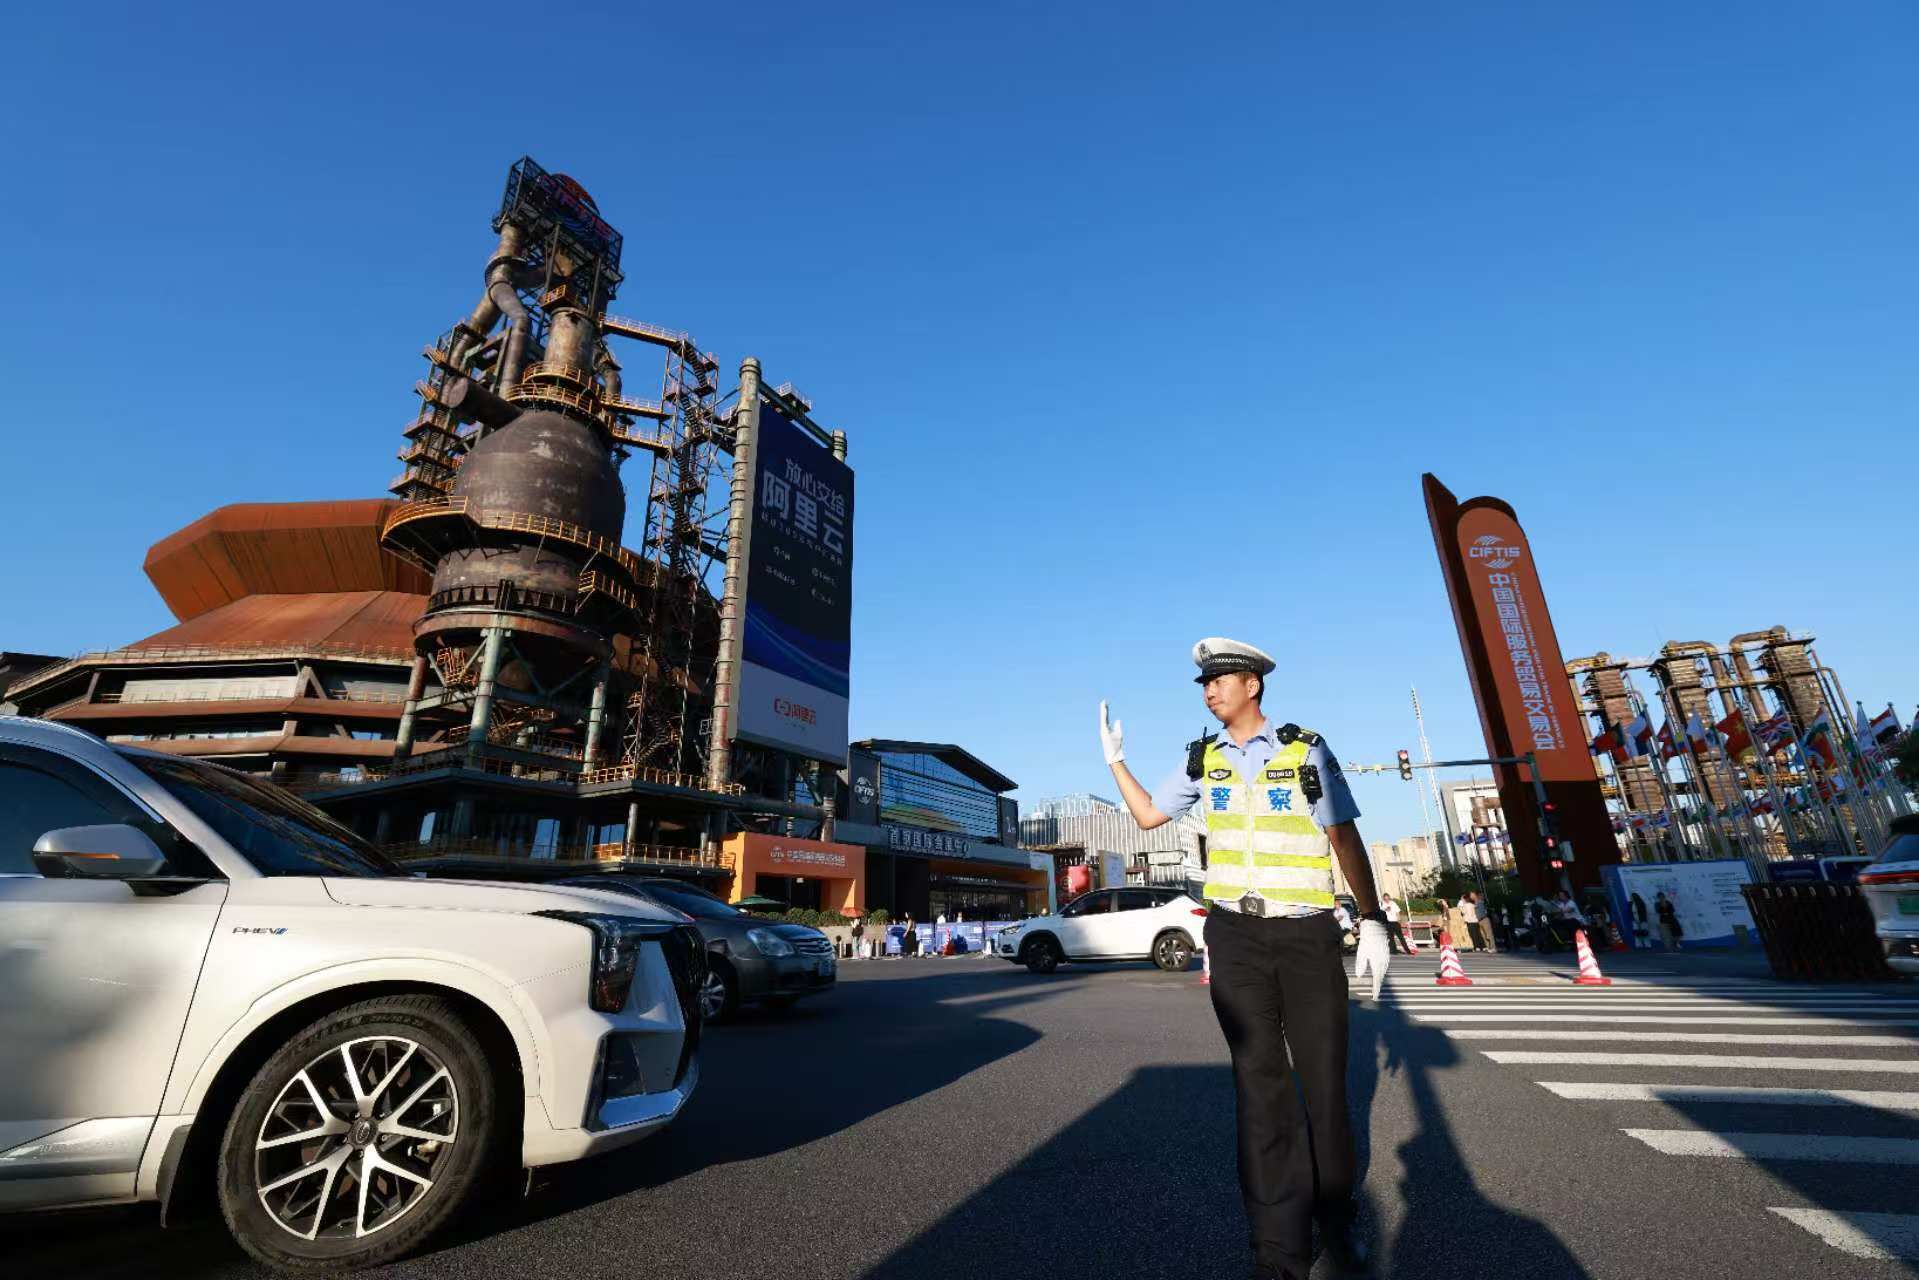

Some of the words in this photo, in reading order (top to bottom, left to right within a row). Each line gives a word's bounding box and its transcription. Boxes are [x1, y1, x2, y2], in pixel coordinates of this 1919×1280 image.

[762, 470, 844, 555] 阿里云
[1469, 546, 1521, 558] CIFTIS
[1488, 572, 1556, 750] 中国国际服务贸易交易会
